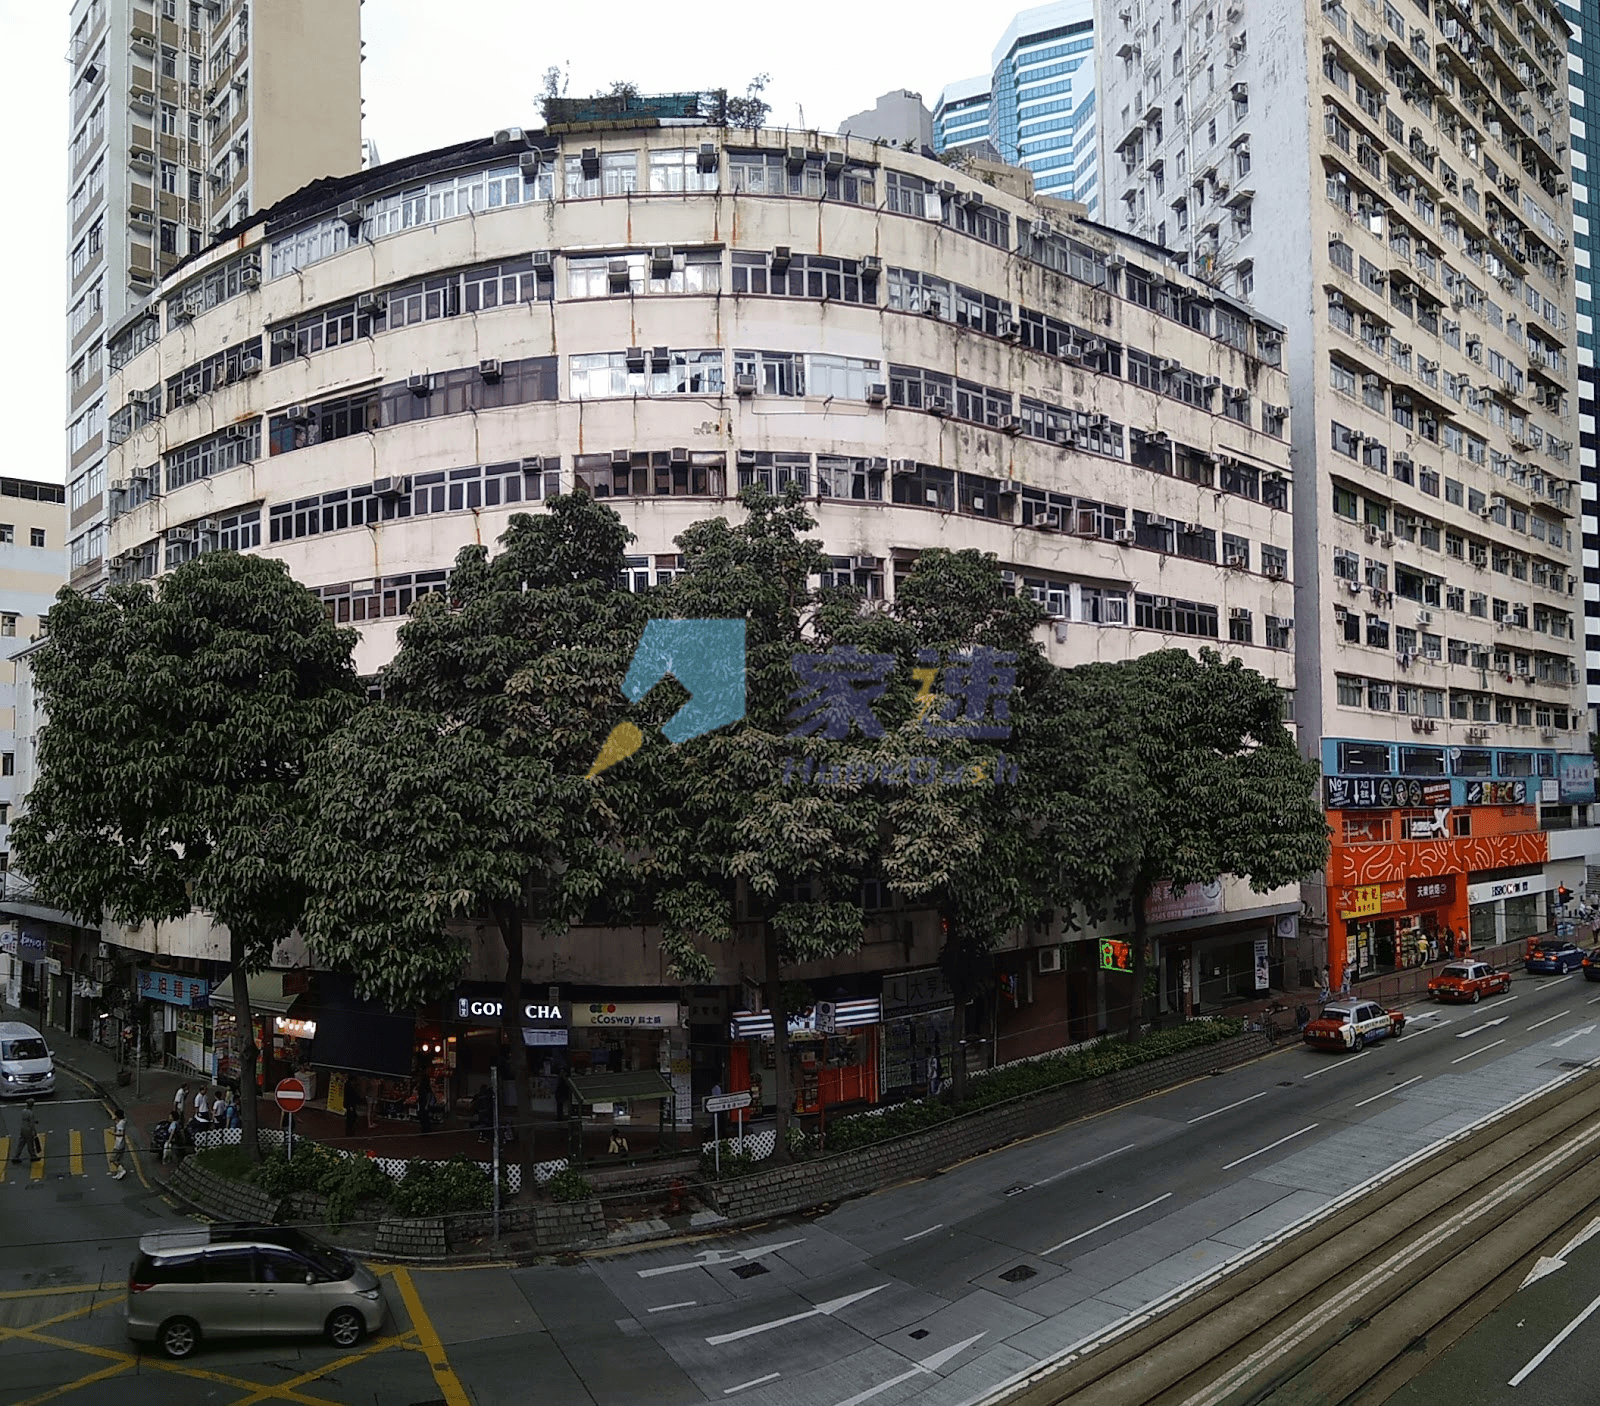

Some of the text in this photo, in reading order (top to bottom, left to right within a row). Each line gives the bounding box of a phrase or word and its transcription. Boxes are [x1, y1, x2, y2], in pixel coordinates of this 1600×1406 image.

[1491, 885, 1507, 897] HSBC
[525, 1005, 562, 1019] CHA
[590, 1014, 636, 1025] eCosway
